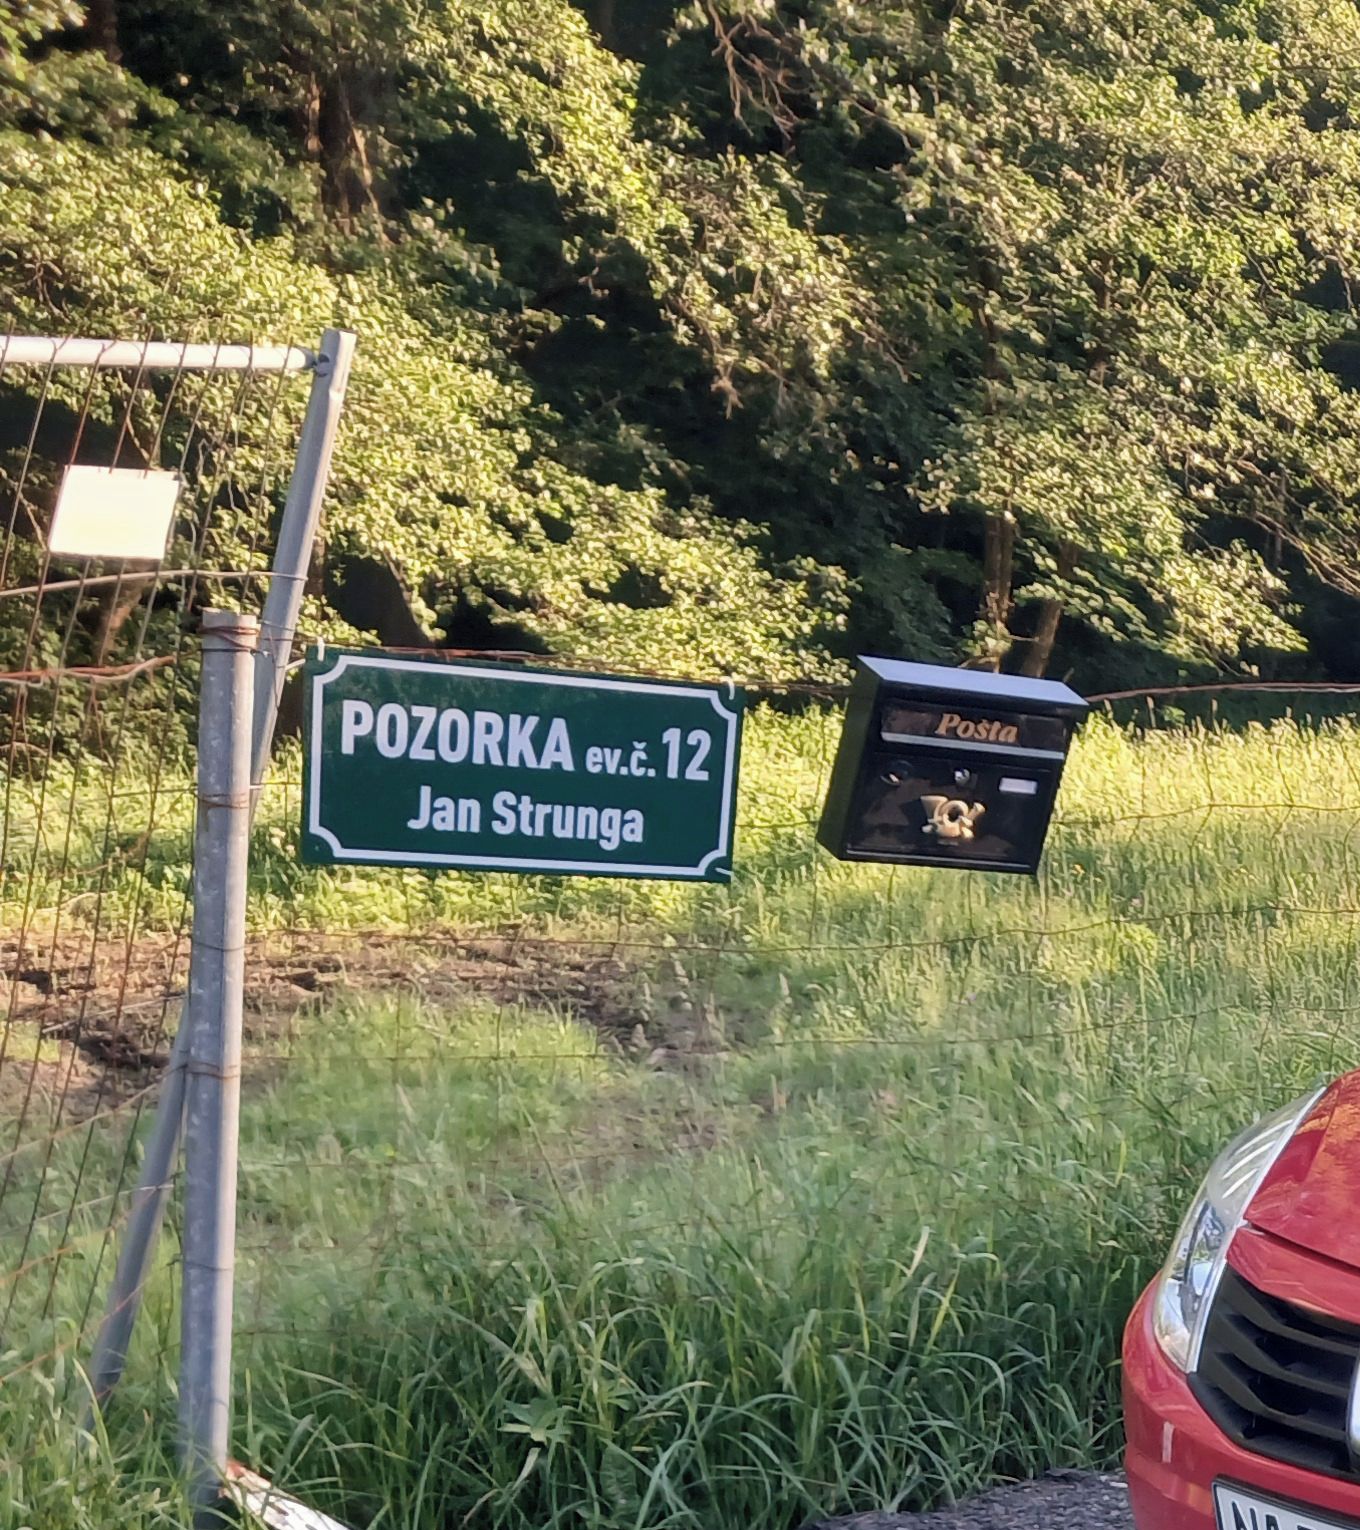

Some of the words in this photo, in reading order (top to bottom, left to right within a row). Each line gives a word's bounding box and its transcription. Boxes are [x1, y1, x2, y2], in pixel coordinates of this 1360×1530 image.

[341, 699, 575, 772] POZORKA
[585, 741, 656, 777] ev.č.
[661, 727, 711, 781] 12
[935, 712, 1020, 744] Pošta
[407, 785, 481, 834] Jan
[491, 791, 644, 850] Strunga
